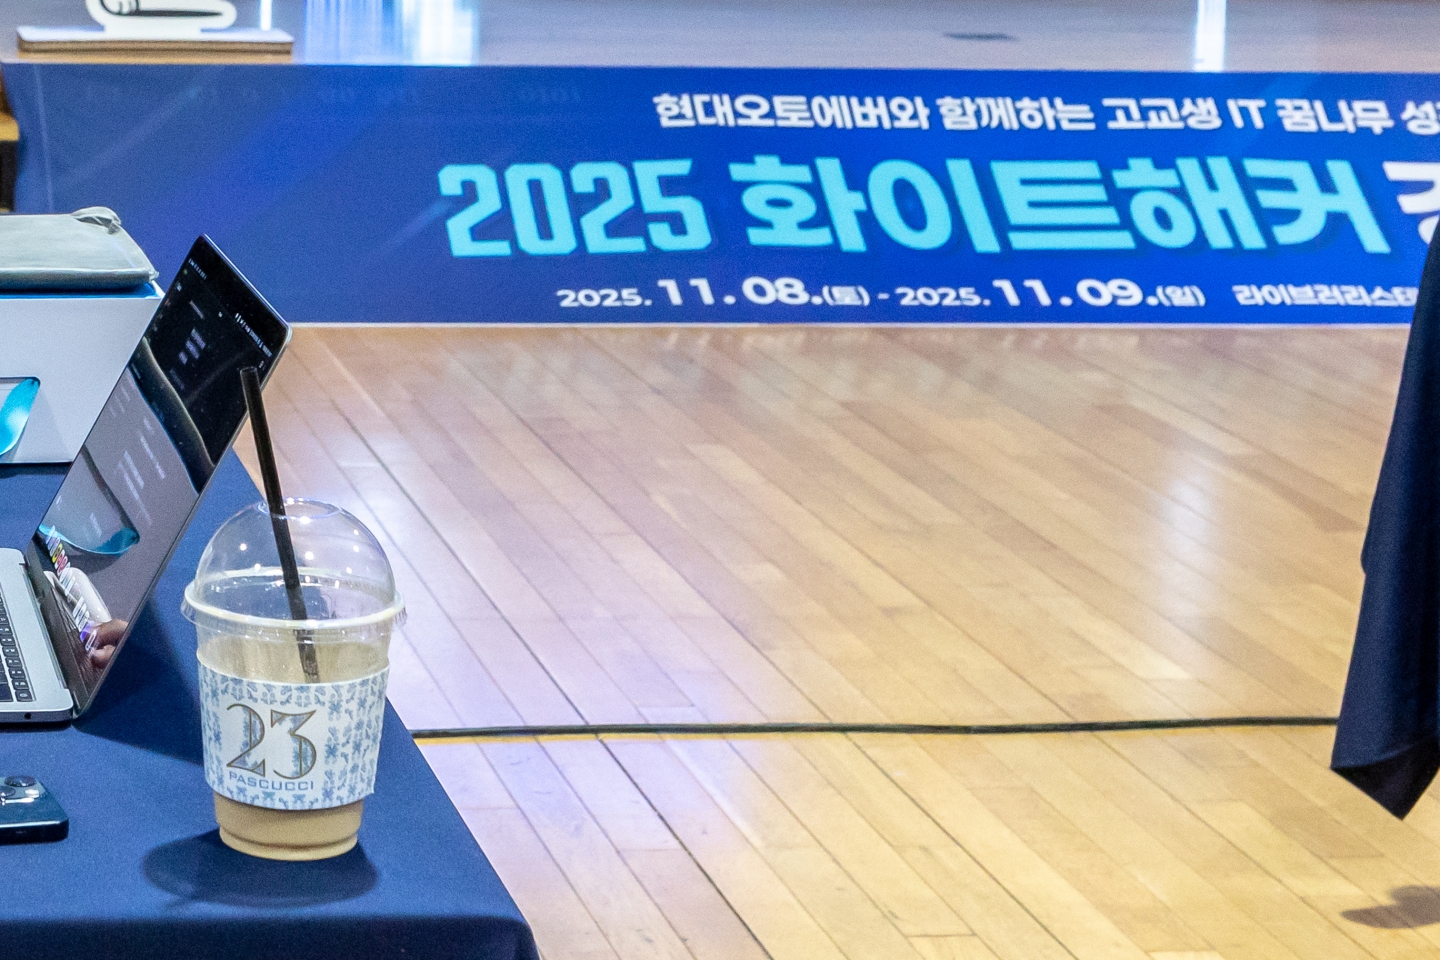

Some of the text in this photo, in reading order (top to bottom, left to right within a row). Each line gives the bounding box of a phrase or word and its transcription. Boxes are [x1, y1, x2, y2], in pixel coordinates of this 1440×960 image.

[653, 93, 929, 131] 현대오토에버와
[935, 96, 1096, 131] 함께하는
[1101, 97, 1223, 130] 고교생
[1227, 98, 1266, 130] IT
[1276, 99, 1395, 136] 꿈나무
[437, 158, 713, 257] 2025
[728, 154, 1392, 254] 화이트해커
[226, 702, 318, 780] 23
[228, 770, 315, 792] PASCUCCI
